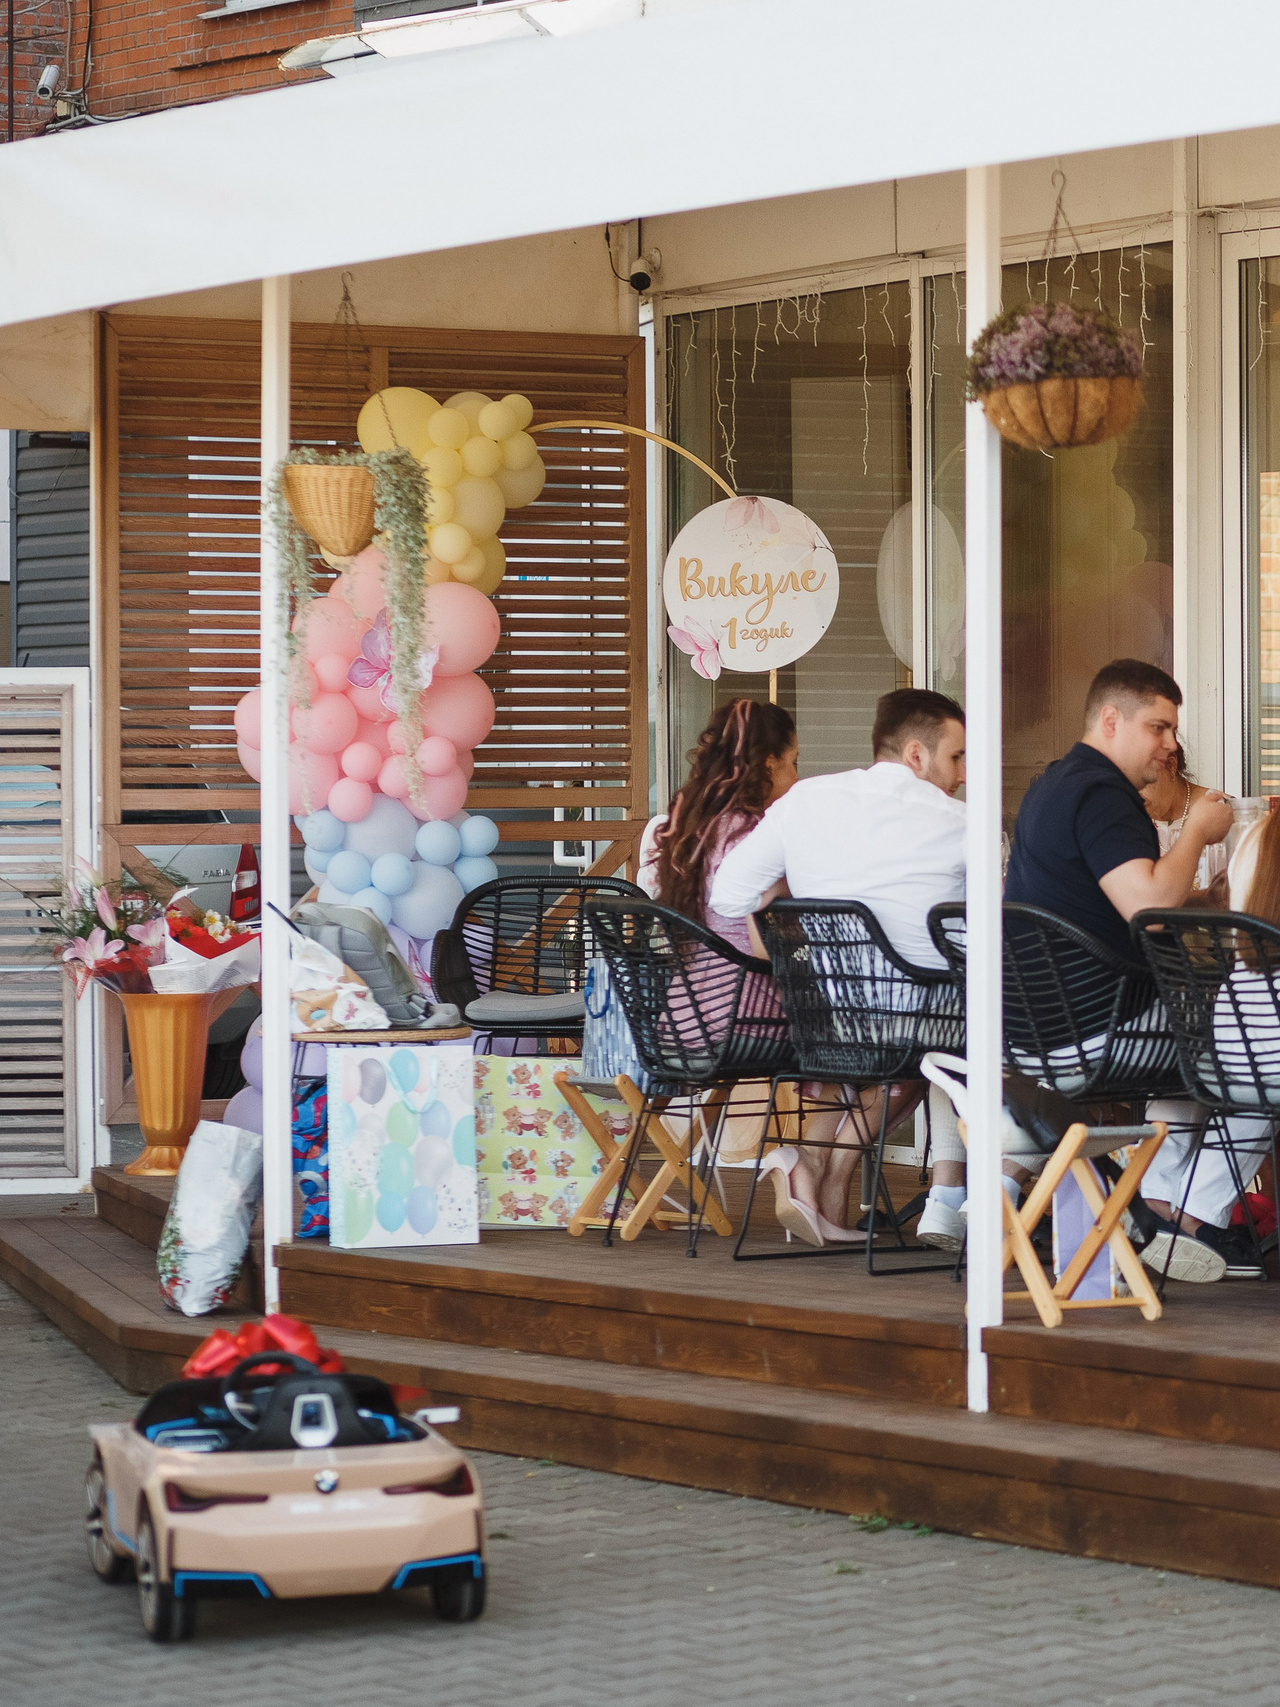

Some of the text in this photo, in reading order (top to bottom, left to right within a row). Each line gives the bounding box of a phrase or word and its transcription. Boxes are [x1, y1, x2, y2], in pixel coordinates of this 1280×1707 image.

[679, 556, 827, 625] Викуле
[720, 617, 794, 652] 1 годик
